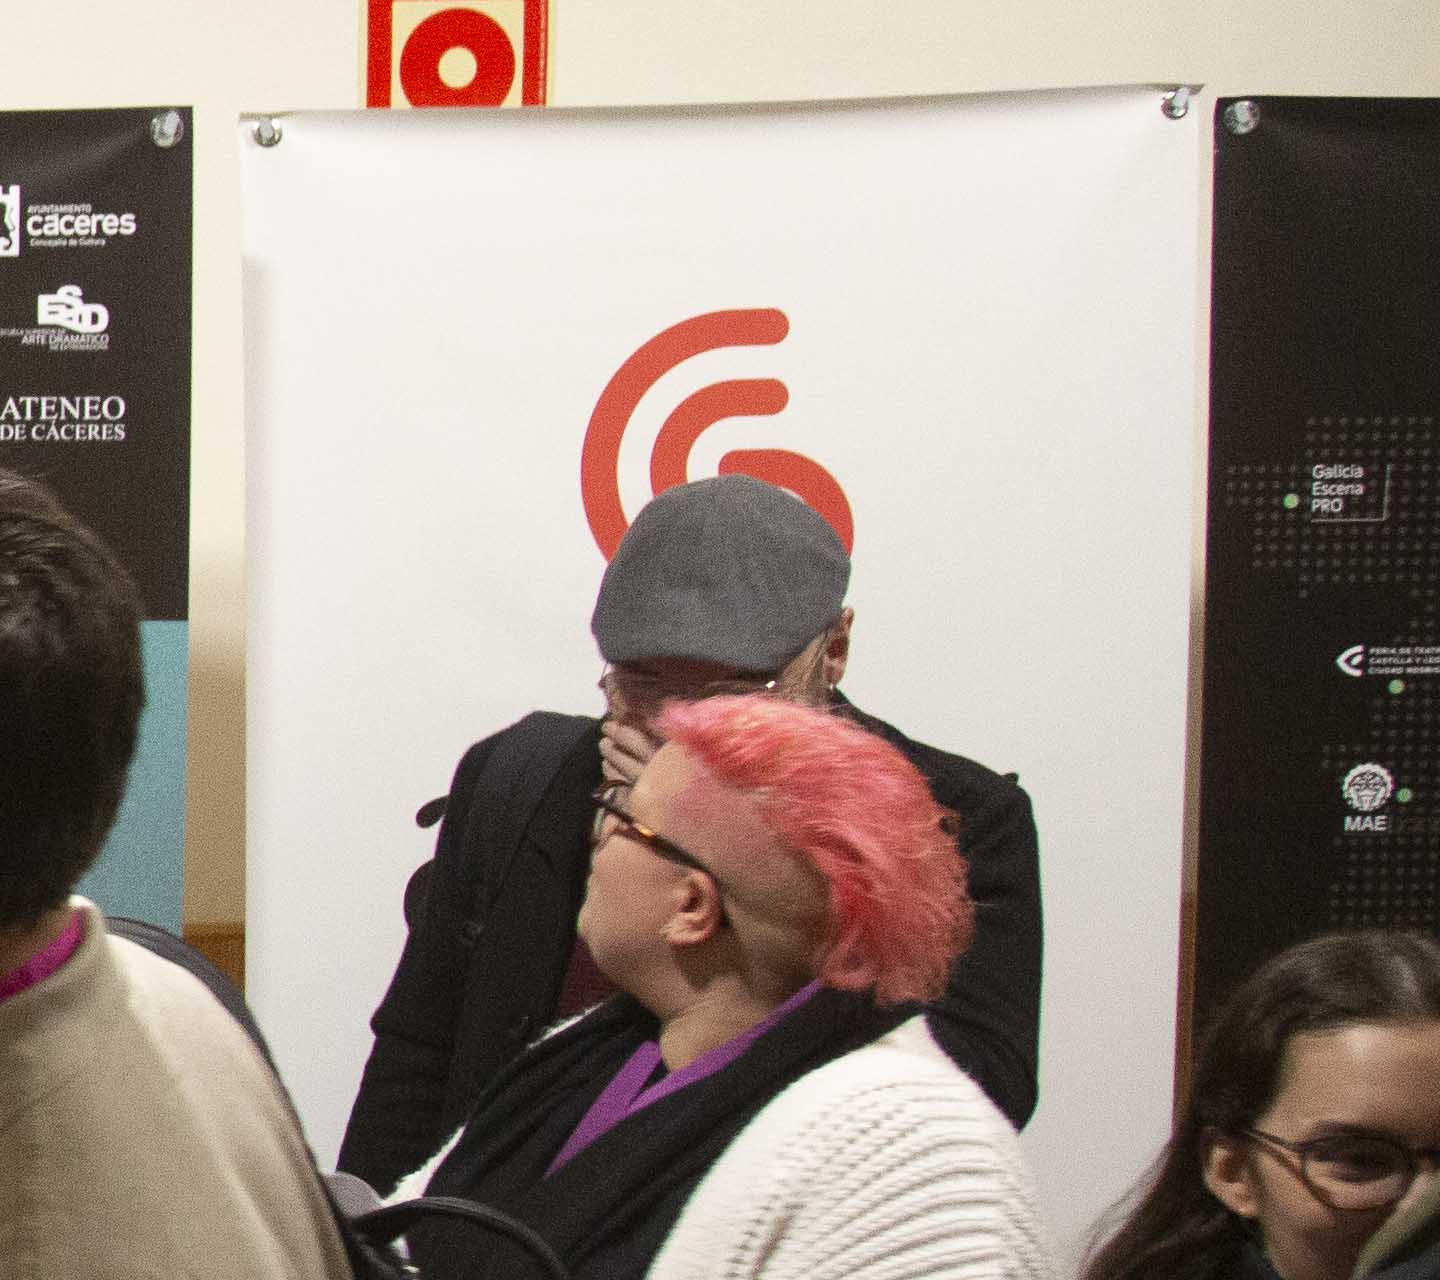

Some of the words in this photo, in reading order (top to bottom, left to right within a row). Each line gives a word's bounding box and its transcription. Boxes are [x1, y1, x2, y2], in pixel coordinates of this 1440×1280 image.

[22, 335, 47, 345] ARTE
[0, 395, 127, 421] ATENEO
[0, 423, 26, 441] DE
[30, 420, 126, 441] CÁCERES
[1312, 464, 1364, 479] Galicia
[1312, 481, 1364, 496] Escena
[1312, 498, 1343, 513] PRO
[1344, 815, 1389, 831] MAE
